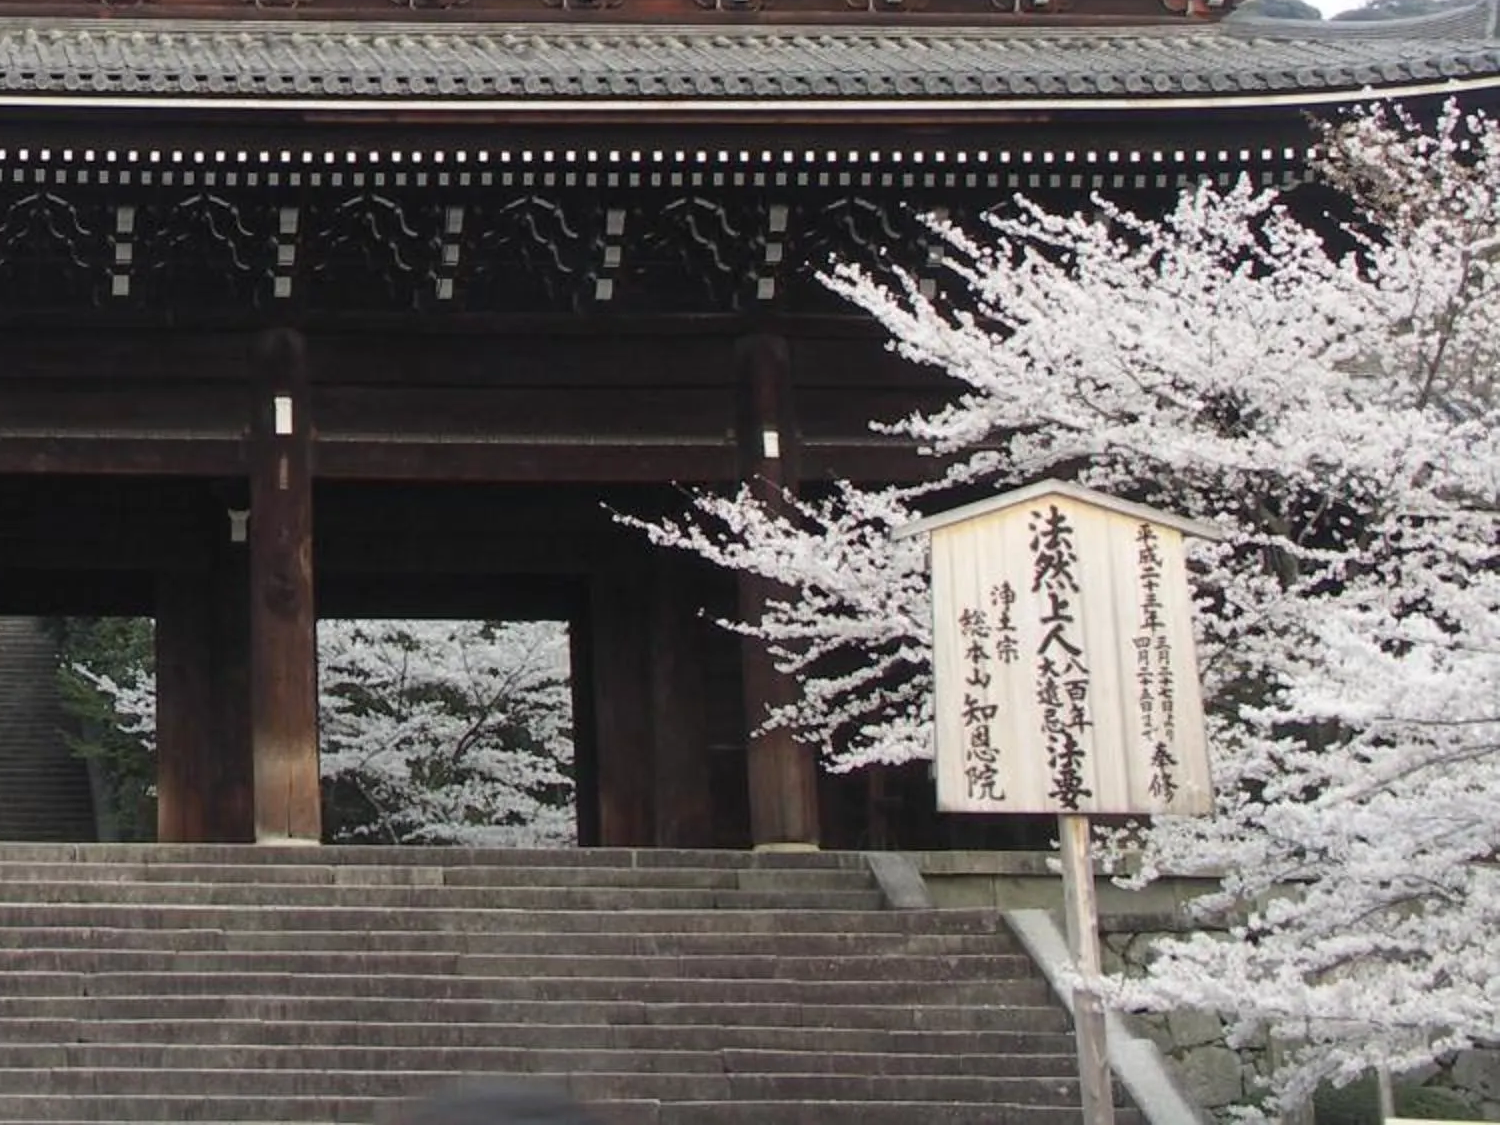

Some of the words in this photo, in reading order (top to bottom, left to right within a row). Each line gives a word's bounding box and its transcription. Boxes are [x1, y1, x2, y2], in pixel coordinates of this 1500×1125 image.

[1029, 505, 1082, 657] 法然上人
[1063, 657, 1094, 735] 八百年
[1047, 735, 1093, 811] 法要
